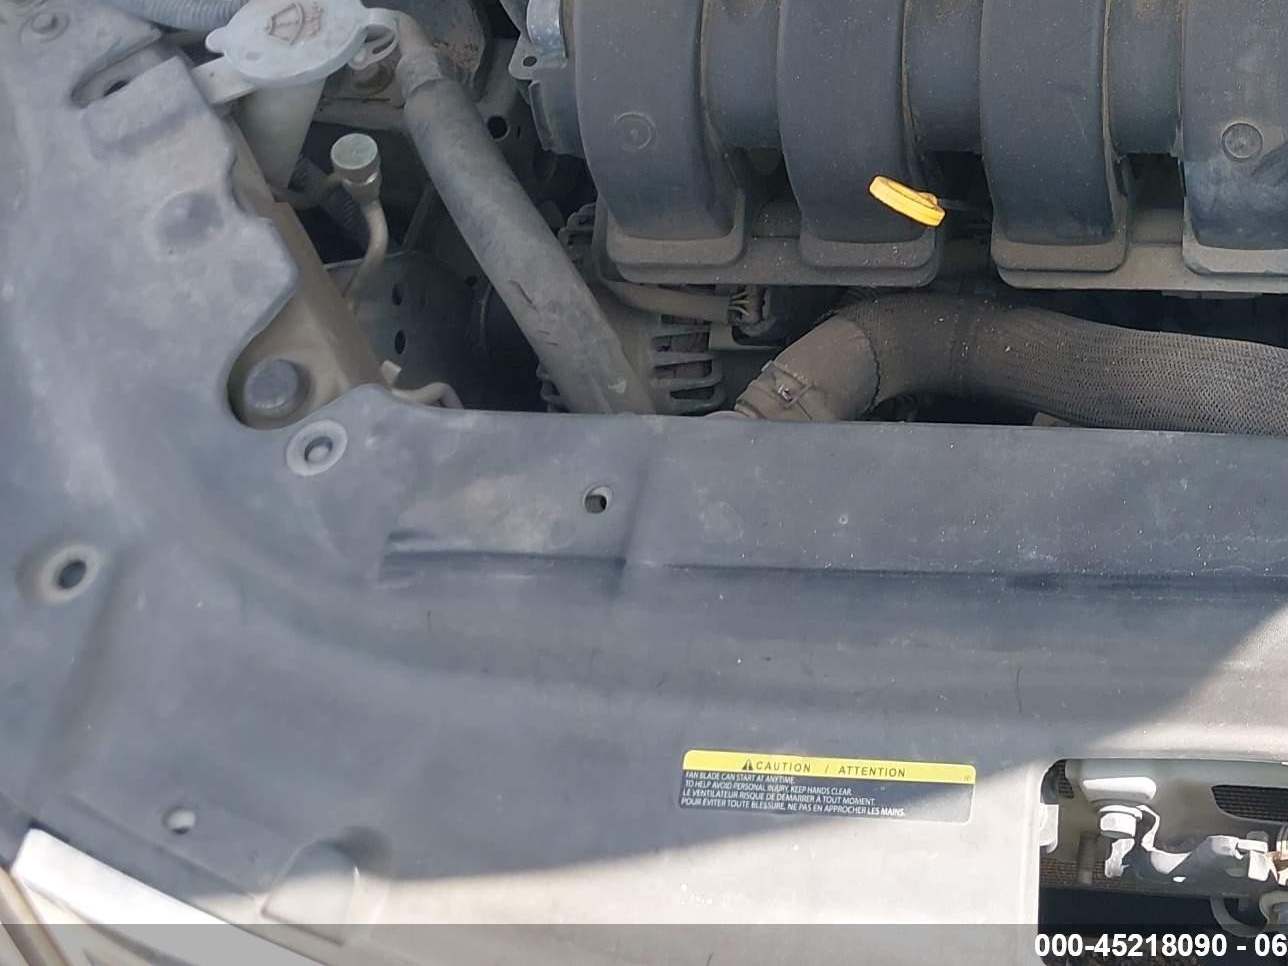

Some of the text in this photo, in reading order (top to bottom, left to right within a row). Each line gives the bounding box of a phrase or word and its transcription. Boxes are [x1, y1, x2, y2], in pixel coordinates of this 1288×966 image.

[685, 770, 698, 778] FAN
[699, 771, 719, 779] BLADE
[721, 772, 735, 780] CAN
[735, 773, 755, 781] START
[755, 774, 764, 782] AT
[755, 761, 810, 772] CAUTION
[838, 765, 905, 777] ATTENTION
[685, 779, 693, 787] TO
[694, 779, 711, 788] HELP
[711, 780, 732, 789] AVOID
[732, 781, 765, 791] PERSONAL
[790, 784, 807, 793] KEEP
[807, 785, 829, 794] HANDS
[682, 787, 690, 796] LE
[692, 787, 737, 798] VENTILATEUR
[739, 790, 764, 800] RISQUE
[766, 791, 775, 800] DE
[822, 794, 842, 804] TOUT
[681, 796, 701, 805] POUR
[727, 798, 749, 808] TOUTE
[787, 802, 797, 810] NE
[798, 802, 811, 811] PAS
[812, 803, 823, 812] EN
[823, 803, 866, 814] APPROCHER
[867, 806, 879, 815] LES
[880, 806, 905, 816] MAINS.
